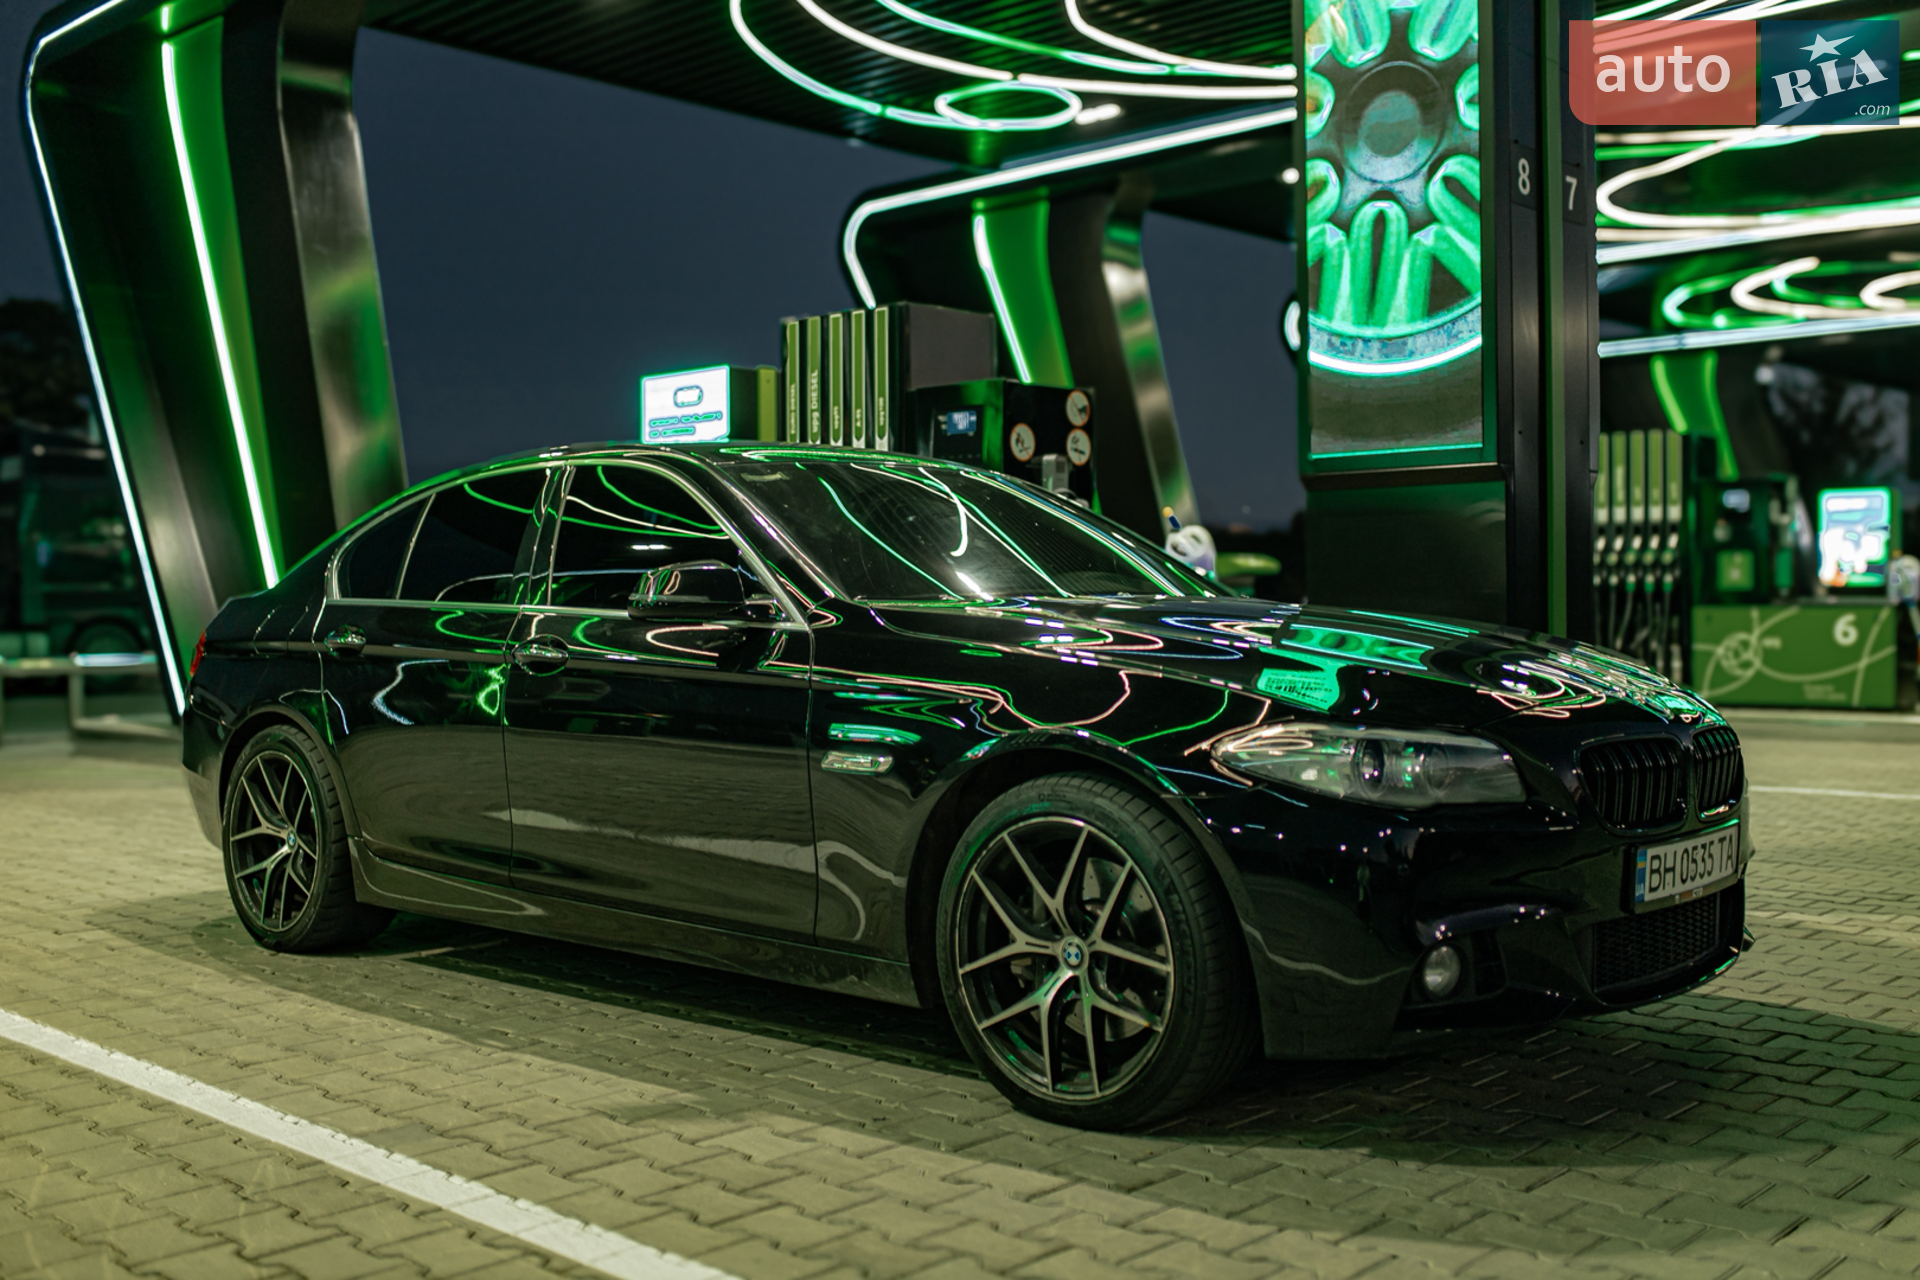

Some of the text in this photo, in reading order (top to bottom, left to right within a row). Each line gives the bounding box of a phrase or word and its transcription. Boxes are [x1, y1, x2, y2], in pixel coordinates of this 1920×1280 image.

[1517, 157, 1531, 195] 8
[1565, 175, 1578, 211] 7
[811, 369, 820, 434] upg DIESEL
[1833, 613, 1858, 646] 6
[1648, 834, 1735, 893] BH 0535 TA
